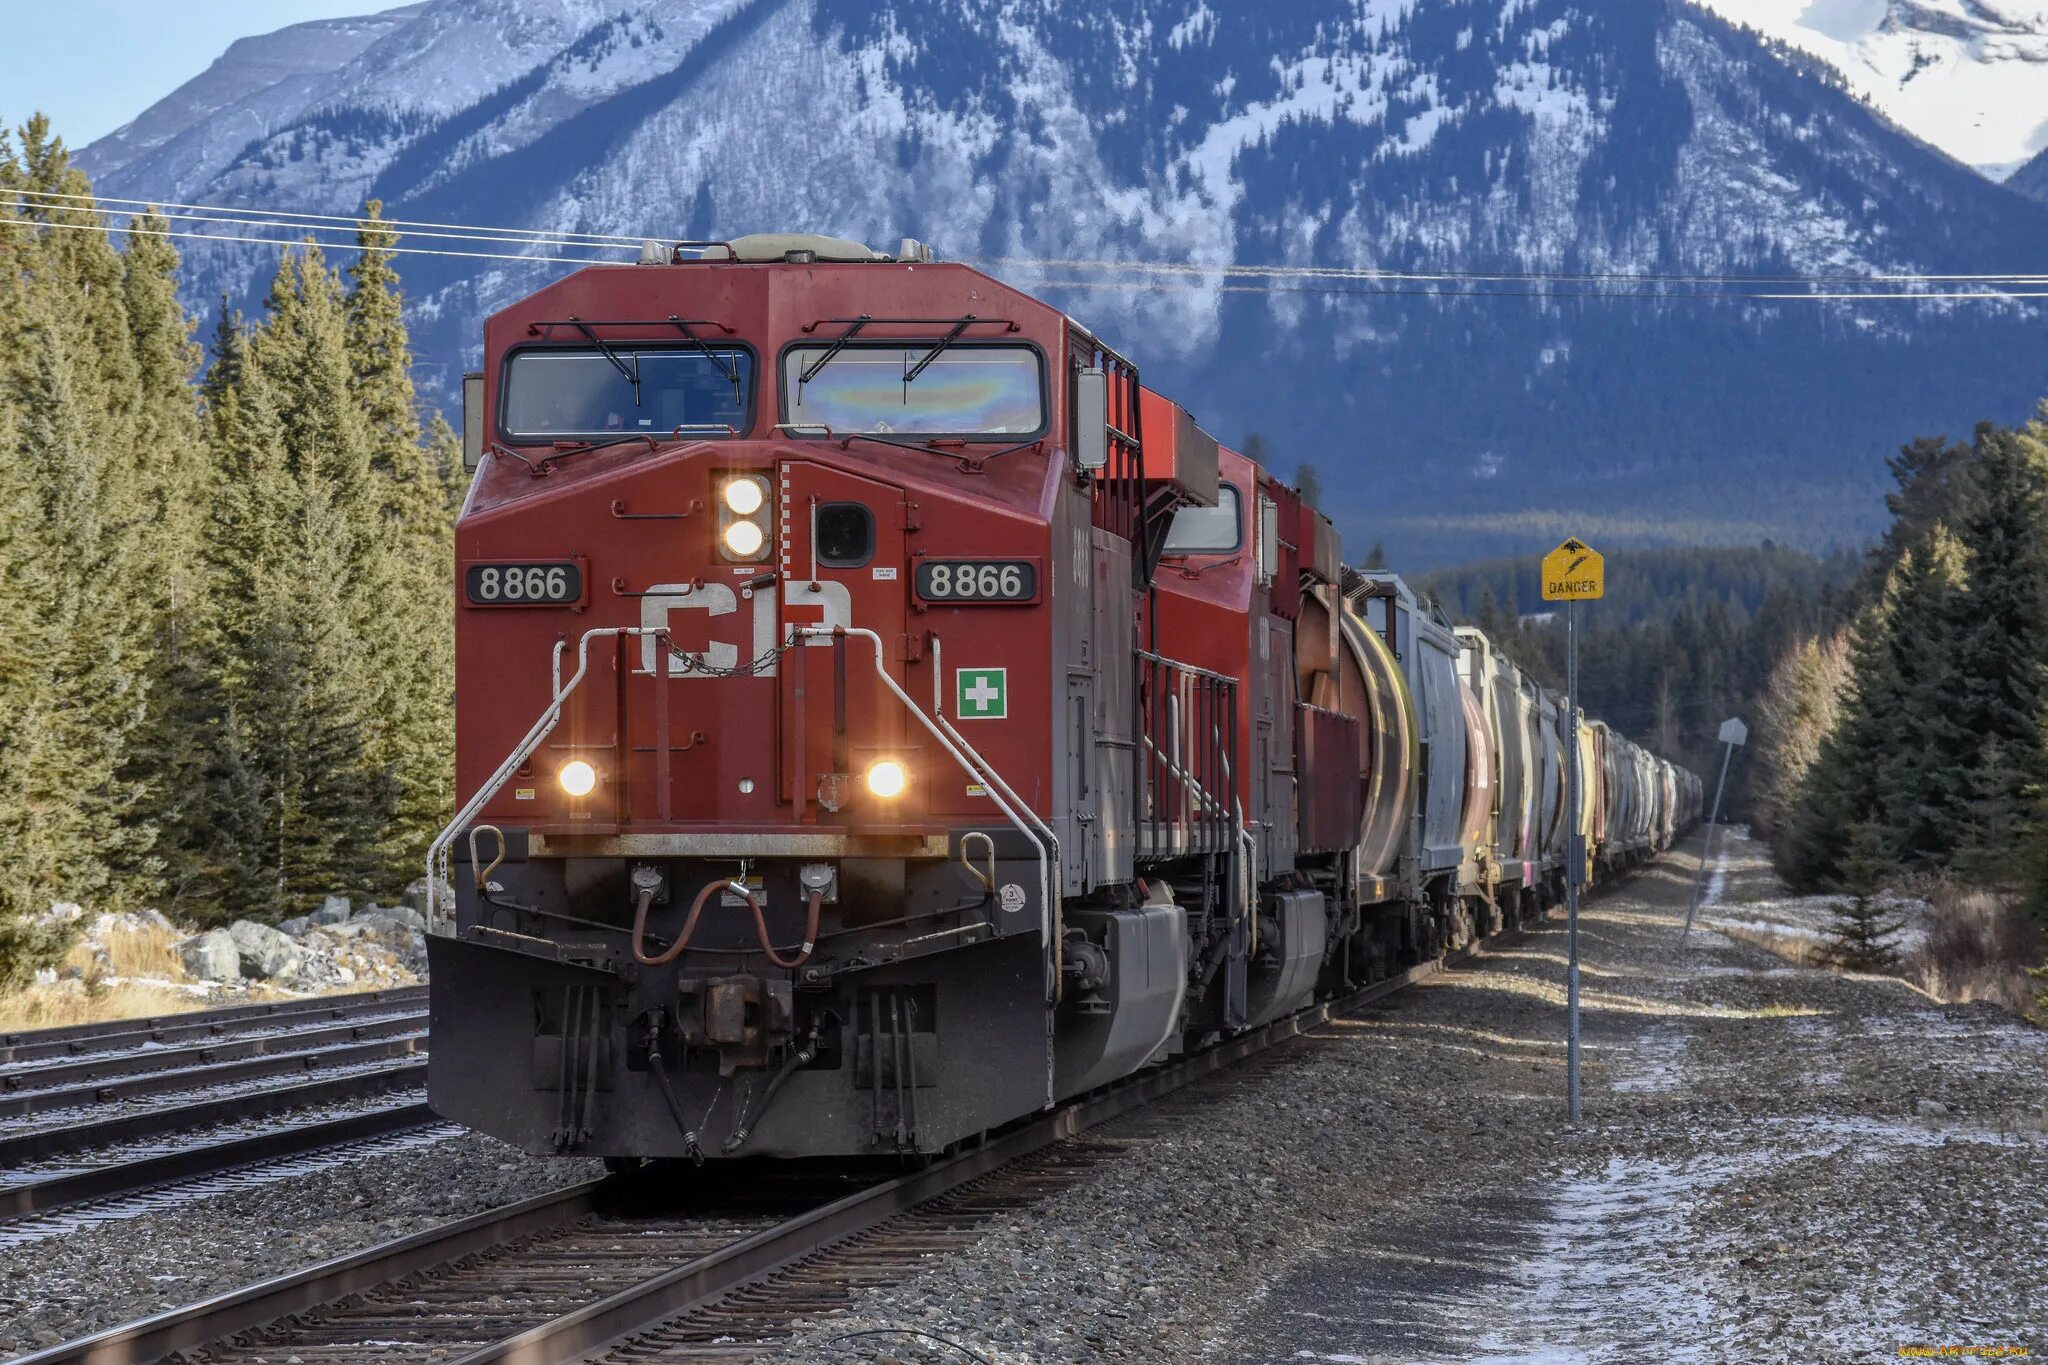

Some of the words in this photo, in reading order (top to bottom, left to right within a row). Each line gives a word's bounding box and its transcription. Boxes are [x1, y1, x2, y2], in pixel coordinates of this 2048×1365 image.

[480, 567, 567, 599] 8866
[930, 564, 1021, 597] 8866
[1549, 580, 1597, 594] DANGER
[641, 580, 852, 678] CP
[1009, 890, 1014, 898] 3
